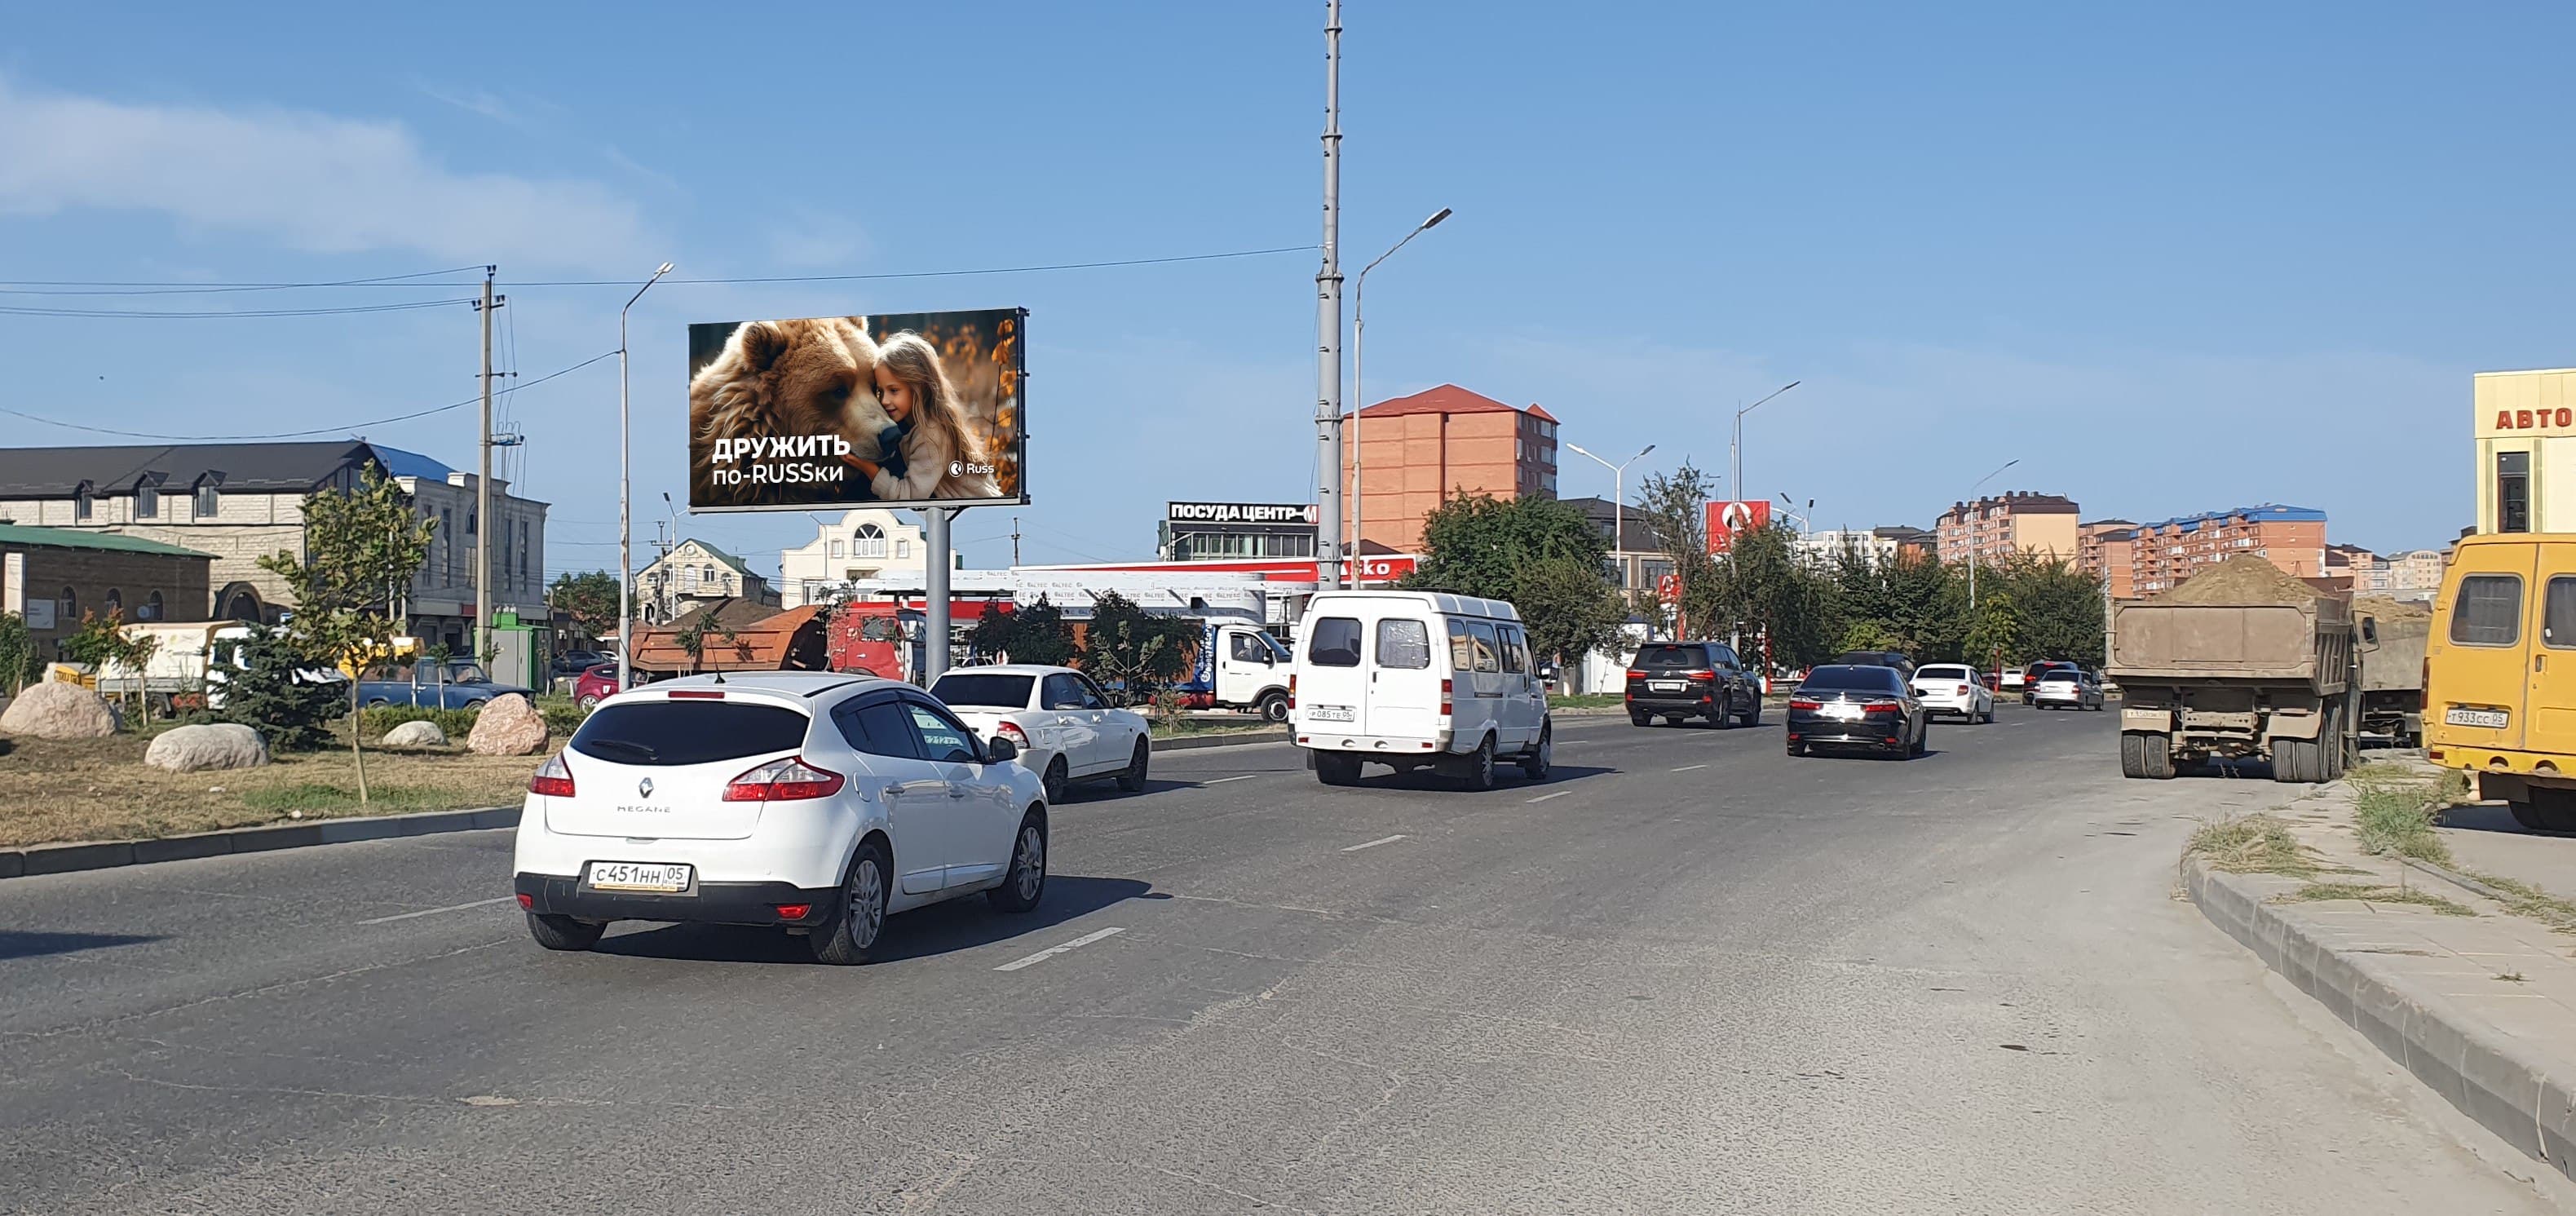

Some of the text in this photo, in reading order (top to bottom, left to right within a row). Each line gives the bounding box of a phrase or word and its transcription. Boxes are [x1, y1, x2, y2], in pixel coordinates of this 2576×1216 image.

[2496, 407, 2576, 430] АВТО
[712, 434, 851, 463] ДРУЖИТЬ
[714, 462, 843, 485] по-RUSSки
[966, 462, 994, 474] Russ
[1171, 504, 1240, 521] ПОСУДА
[2451, 712, 2503, 724] Т933СС 05
[596, 865, 684, 884] С451НН 05
